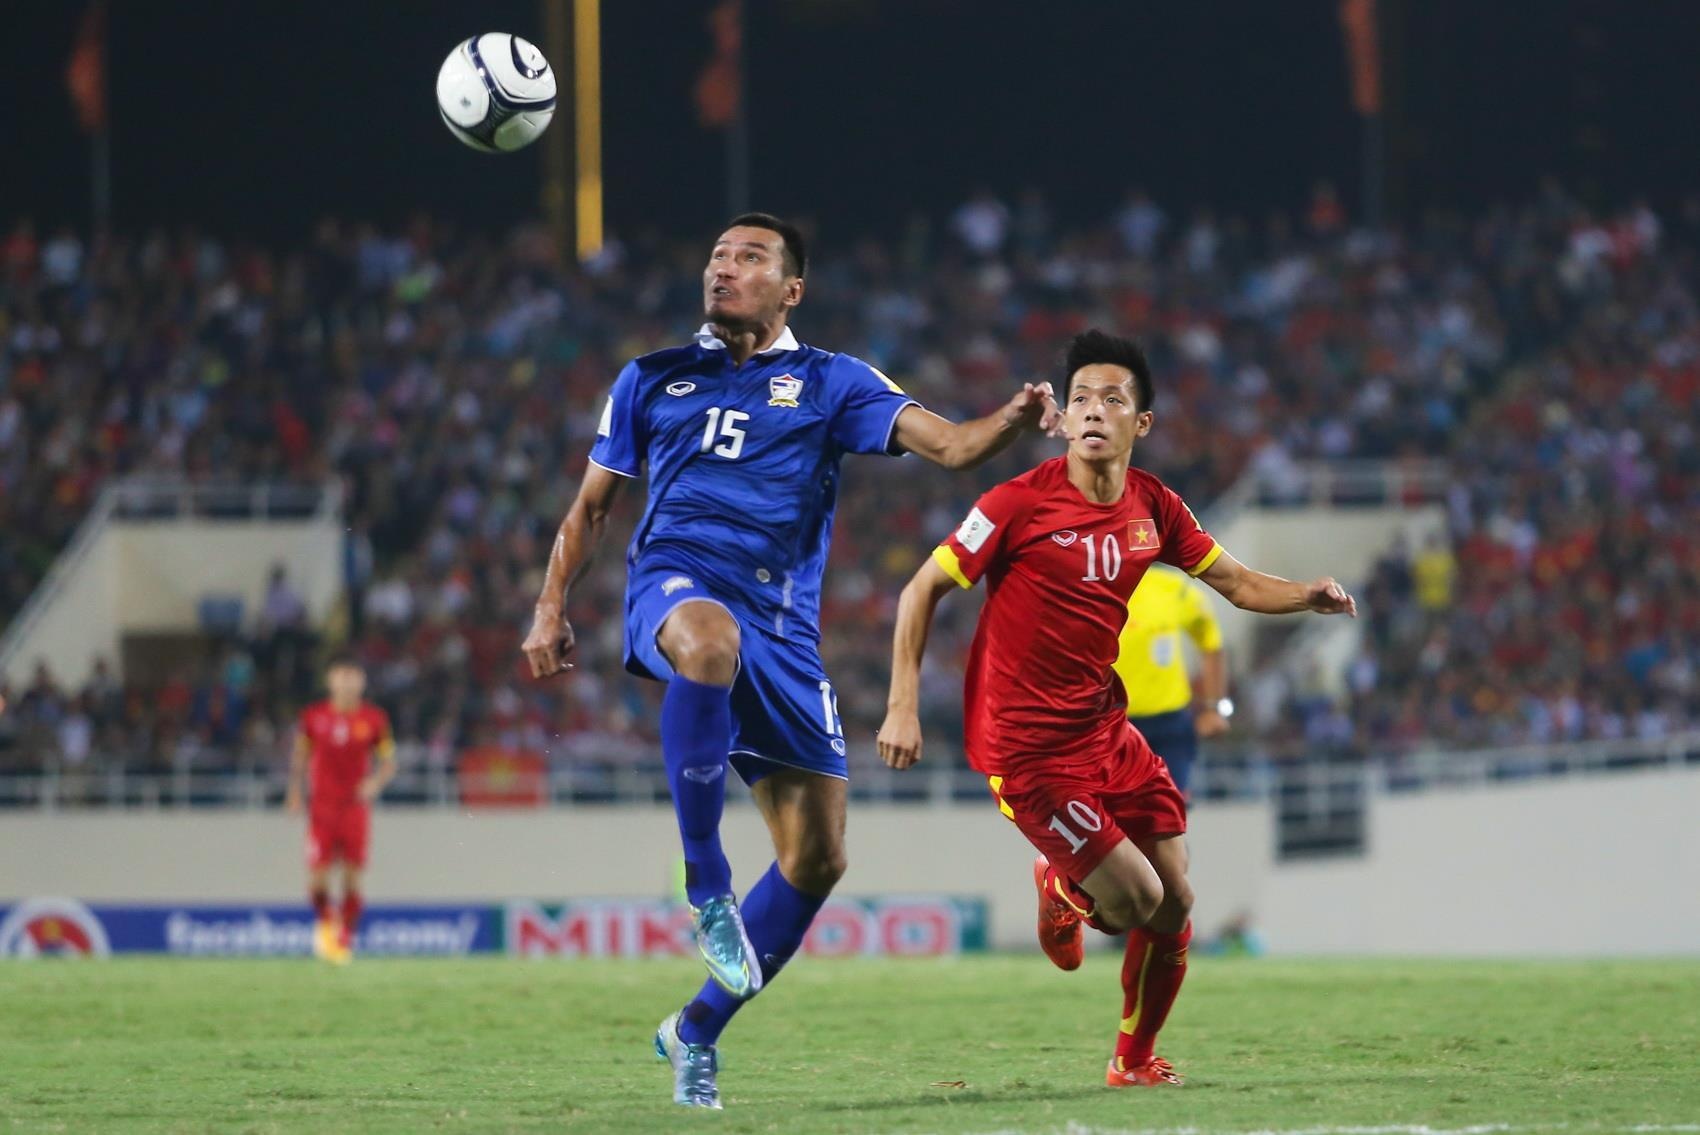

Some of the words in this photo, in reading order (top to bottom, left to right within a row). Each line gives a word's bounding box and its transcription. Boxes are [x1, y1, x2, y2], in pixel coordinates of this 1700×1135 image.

[702, 406, 750, 460] 15
[1081, 533, 1122, 582] 10
[1048, 800, 1102, 855] 10
